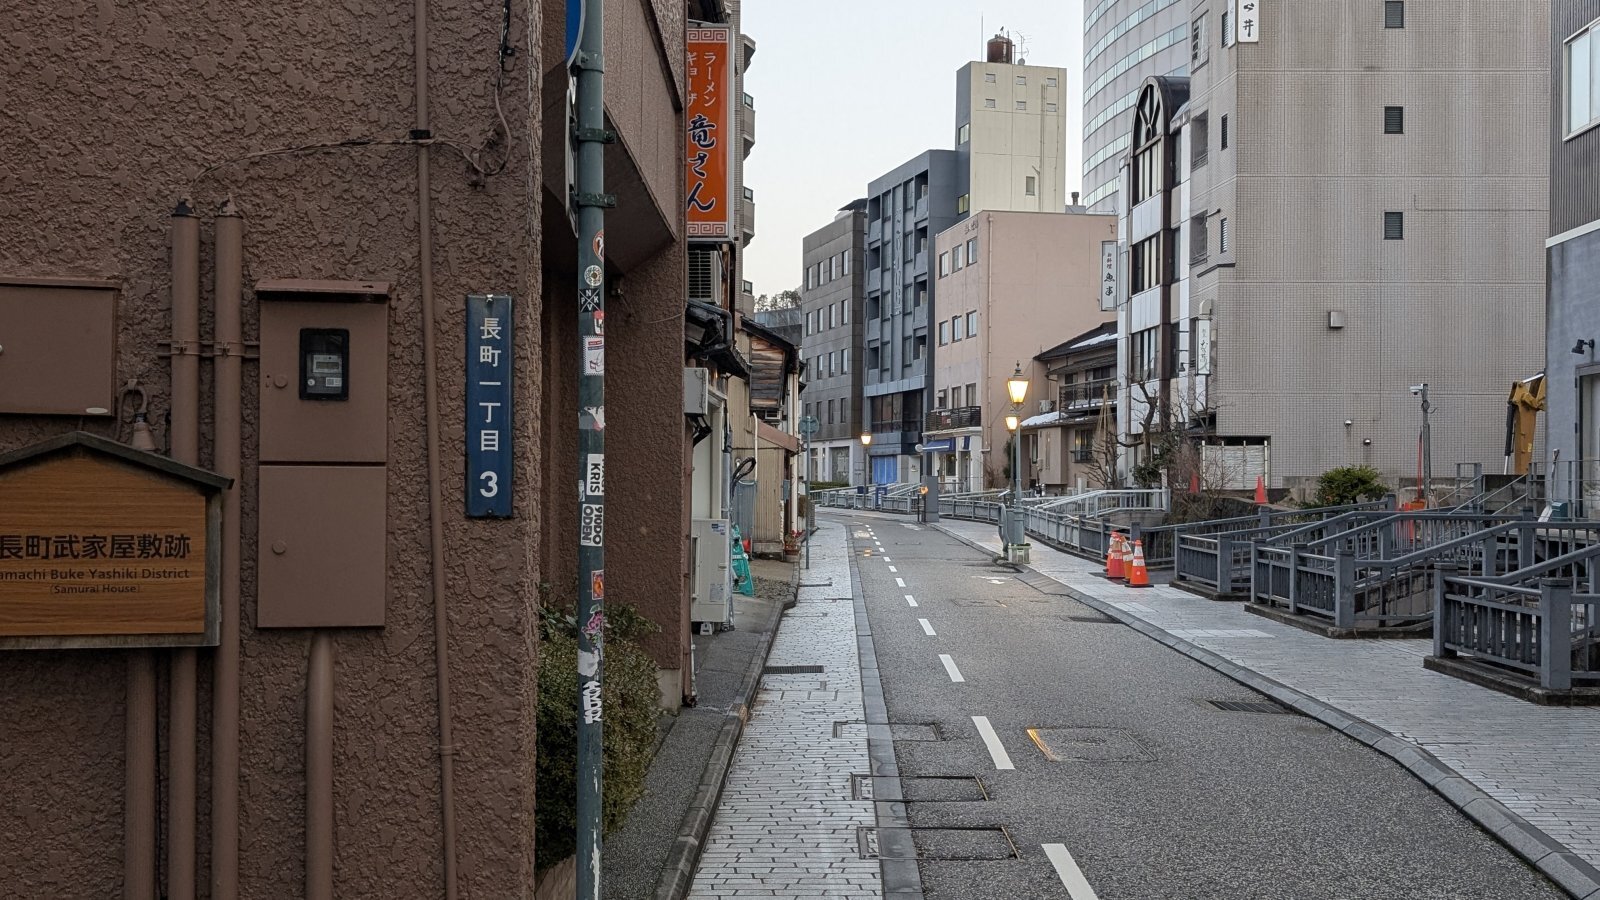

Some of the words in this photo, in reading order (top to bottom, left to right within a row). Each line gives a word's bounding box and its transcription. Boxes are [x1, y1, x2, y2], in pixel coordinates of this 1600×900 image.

[703, 52, 716, 107] ラーメン
[687, 114, 716, 213] 竜さん
[479, 317, 502, 452] 長町一丁目
[479, 470, 498, 498] 3
[590, 463, 601, 494] KRIS
[0, 534, 191, 560] 長町武家屋敷跡
[51, 568, 84, 580] Buke
[89, 568, 137, 580] Yashiki
[142, 567, 190, 579] District
